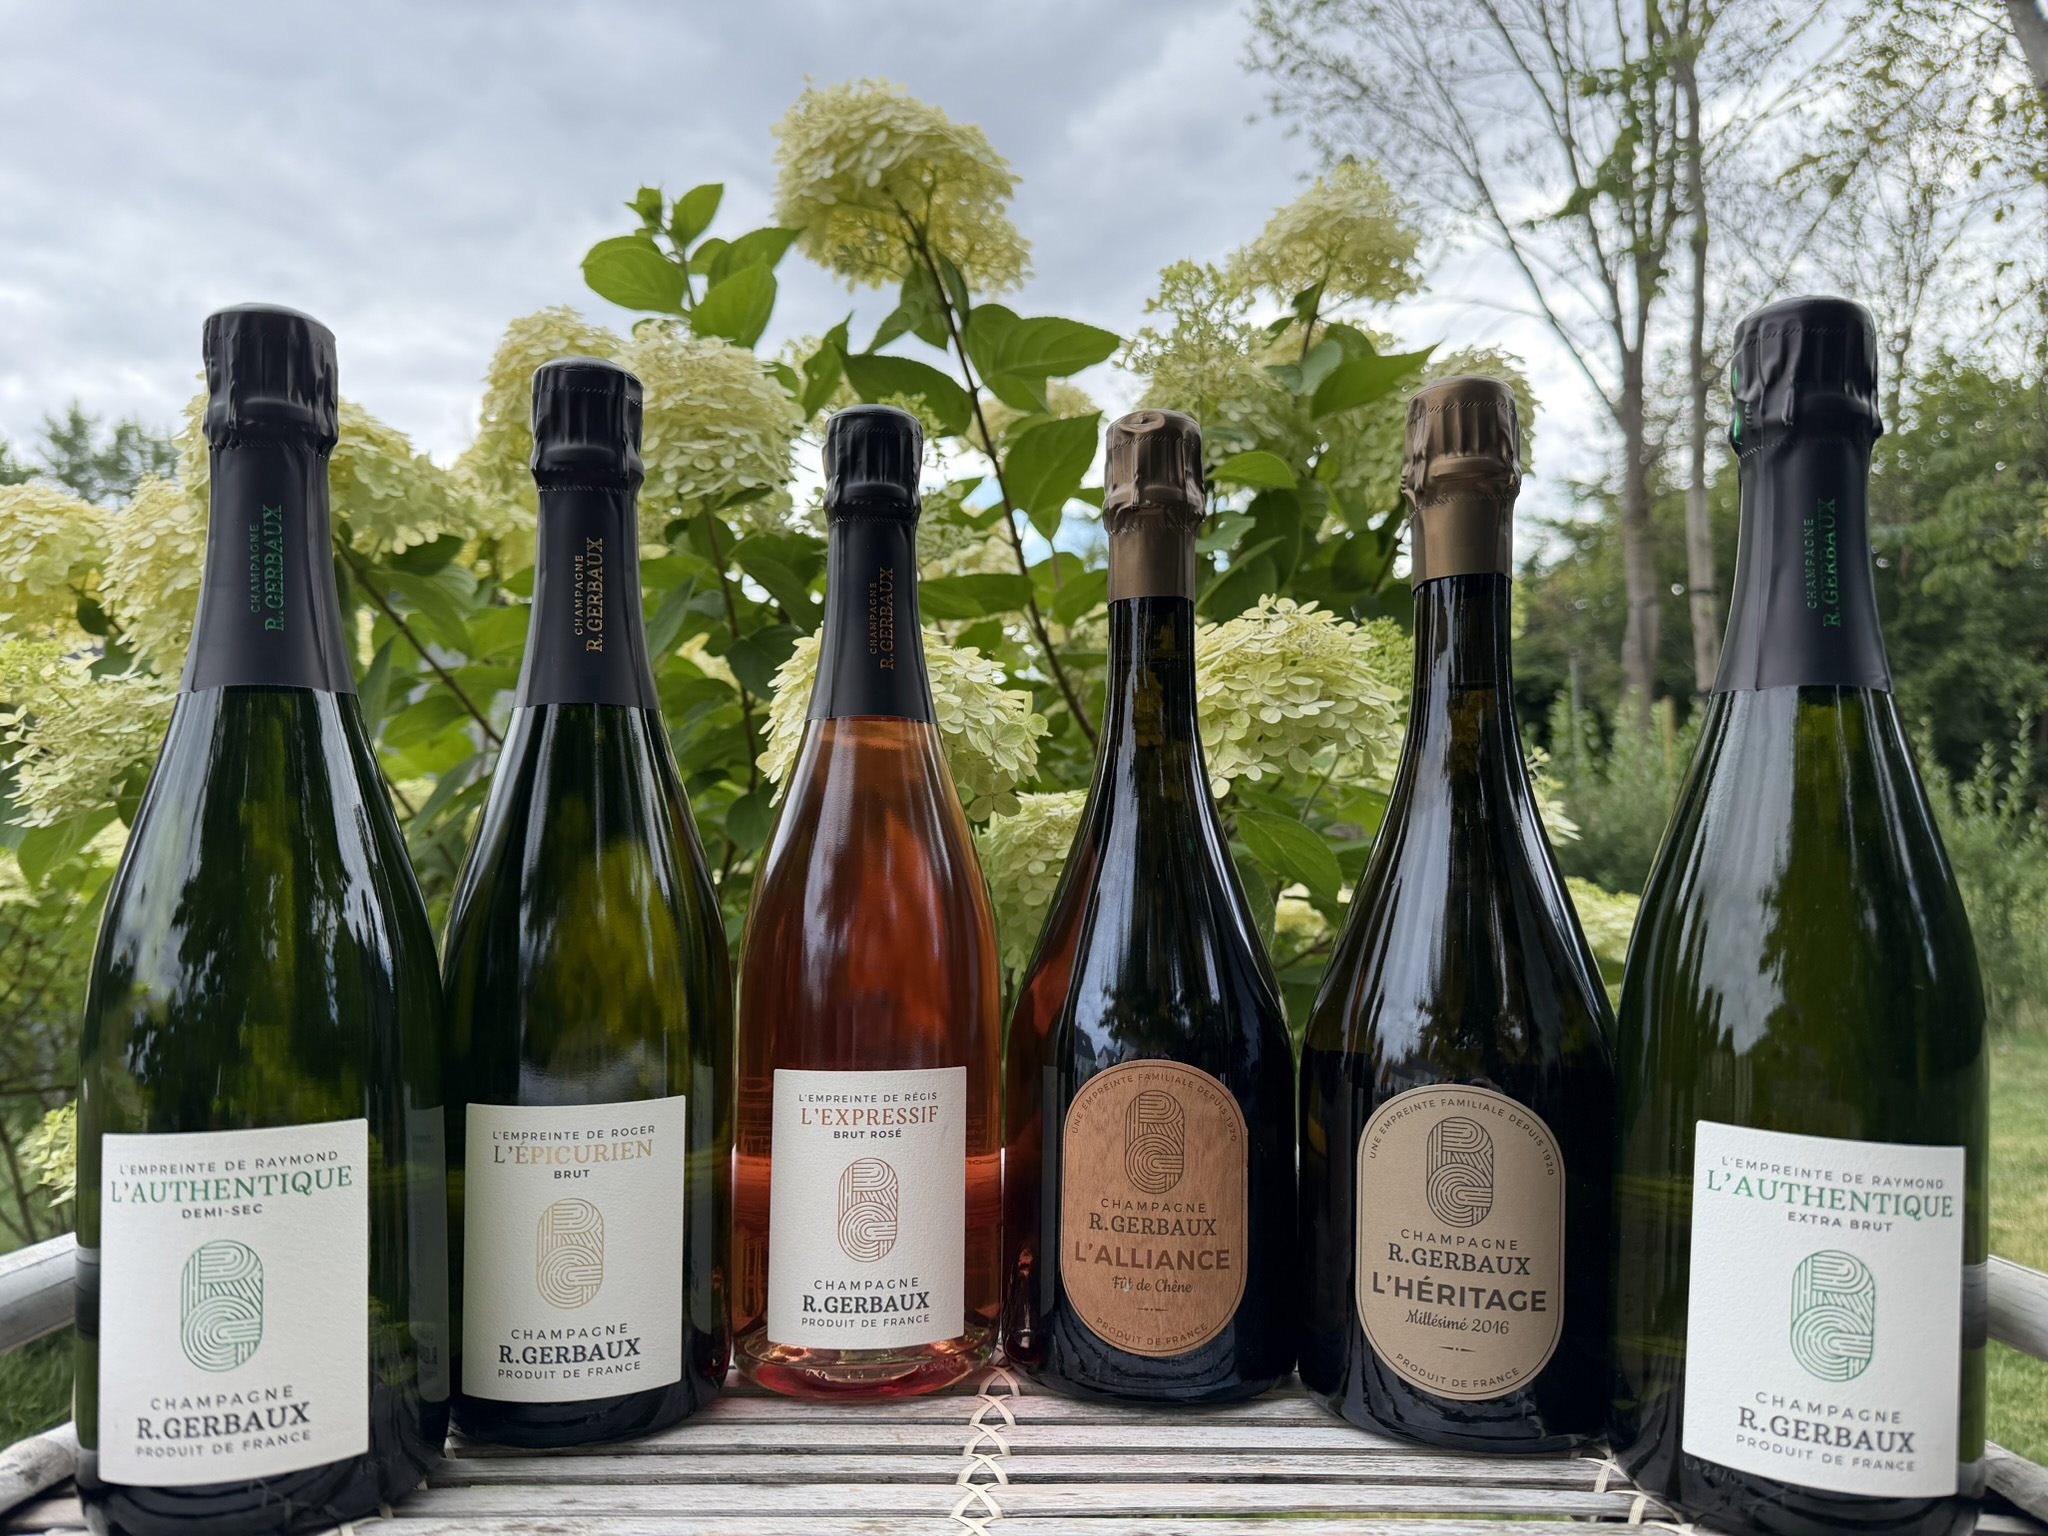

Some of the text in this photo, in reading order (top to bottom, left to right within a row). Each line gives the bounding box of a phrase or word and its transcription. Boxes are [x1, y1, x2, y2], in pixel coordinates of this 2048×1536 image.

[250, 524, 260, 613] CHAMPAGNE
[263, 504, 284, 631] R.GERBAUX
[1804, 518, 1817, 609] CHAMPAGNE
[1818, 498, 1840, 627] R.GERBAUX
[574, 554, 584, 636] CHAMPAGNE
[586, 537, 604, 652] R.GERBAUX
[869, 582, 878, 655] CHAMPAGNE
[880, 567, 894, 670] R.GERBAUX
[798, 1091, 938, 1103] L'EMPREINTE DE RÉGIS
[1072, 1073, 1237, 1142] UNE EMPREINTE FAMILIALE DEPUIS 1920
[801, 1106, 938, 1126] L'EXPRESSIF
[493, 1124, 656, 1140] L'EMPREINTE DE ROGER
[834, 1128, 902, 1140] BRUT ROSÉ
[1370, 1098, 1555, 1176] UNE EMPREINTE FAMILIALE DEPUIS 1920
[119, 1151, 338, 1175] L'EMPREINTE DE RAYMOND
[494, 1139, 654, 1166] L'ÉPICURIEN
[111, 1165, 352, 1204] L'AUTHENTIQUE
[554, 1169, 590, 1180] BRUT
[1722, 1156, 1944, 1190] L'EMPREINTE DE RAYMOND
[1100, 1198, 1206, 1213] CHAMPAGNE
[1707, 1169, 1954, 1220] L'AUTHENTIQUE
[182, 1204, 264, 1219] DEMI-SEC
[1089, 1212, 1217, 1236] R.GERBAUX
[1788, 1211, 1892, 1233] EXTRA BRUT
[1401, 1228, 1518, 1250] CHAMPAGNE
[1074, 1241, 1230, 1270] L'ALLIANCE
[1388, 1242, 1531, 1276] R.GERBAUX
[814, 1277, 920, 1290] CHAMPAGNE
[1136, 1278, 1152, 1292] de
[1155, 1279, 1192, 1294] Chêne
[1372, 1271, 1547, 1312] L'HÉRITAGE
[802, 1291, 930, 1314] R.GERBAUX
[511, 1322, 628, 1340] CHAMPAGNE
[802, 1314, 930, 1328] PRODUIT DE FRANCE
[1096, 1317, 1208, 1346] PRODUIT DE FRANCE
[1405, 1309, 1510, 1335] Millésimé 2016
[498, 1338, 641, 1364] R.GERBAUX
[498, 1361, 641, 1380] PRODUIT DE FRANCE
[1396, 1353, 1520, 1388] PRODUIT DE FRANCE
[150, 1385, 294, 1411] CHAMPAGNE
[1756, 1392, 1902, 1425] CHAMPAGNE
[136, 1402, 311, 1440] R.GERBAUX
[1738, 1406, 1916, 1454] R.GERBAUX
[136, 1430, 311, 1458] PRODUIT DE FRANCE
[1736, 1434, 1916, 1472] PRODUIT DE FRANCE
